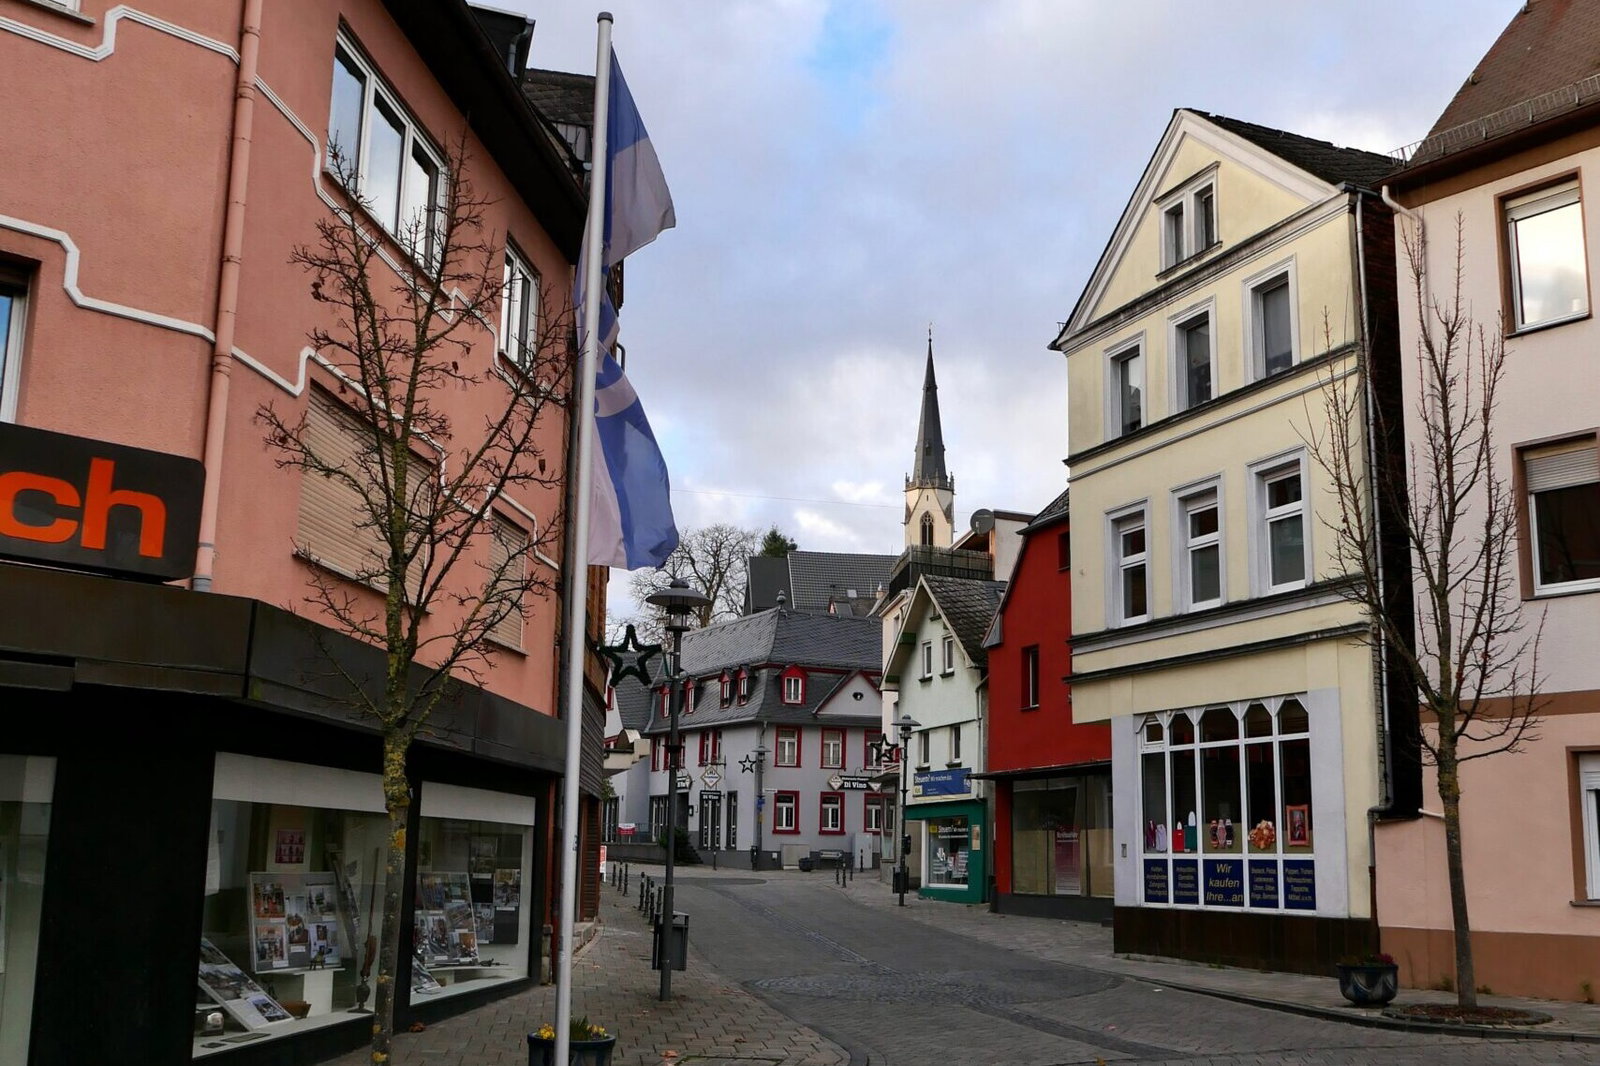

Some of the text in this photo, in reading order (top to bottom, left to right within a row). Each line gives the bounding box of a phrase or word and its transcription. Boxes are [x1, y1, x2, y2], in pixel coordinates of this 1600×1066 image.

[0, 457, 167, 558] ch
[852, 781, 867, 789] Vino
[1216, 863, 1233, 874] Wir
[1208, 877, 1240, 888] kaufen
